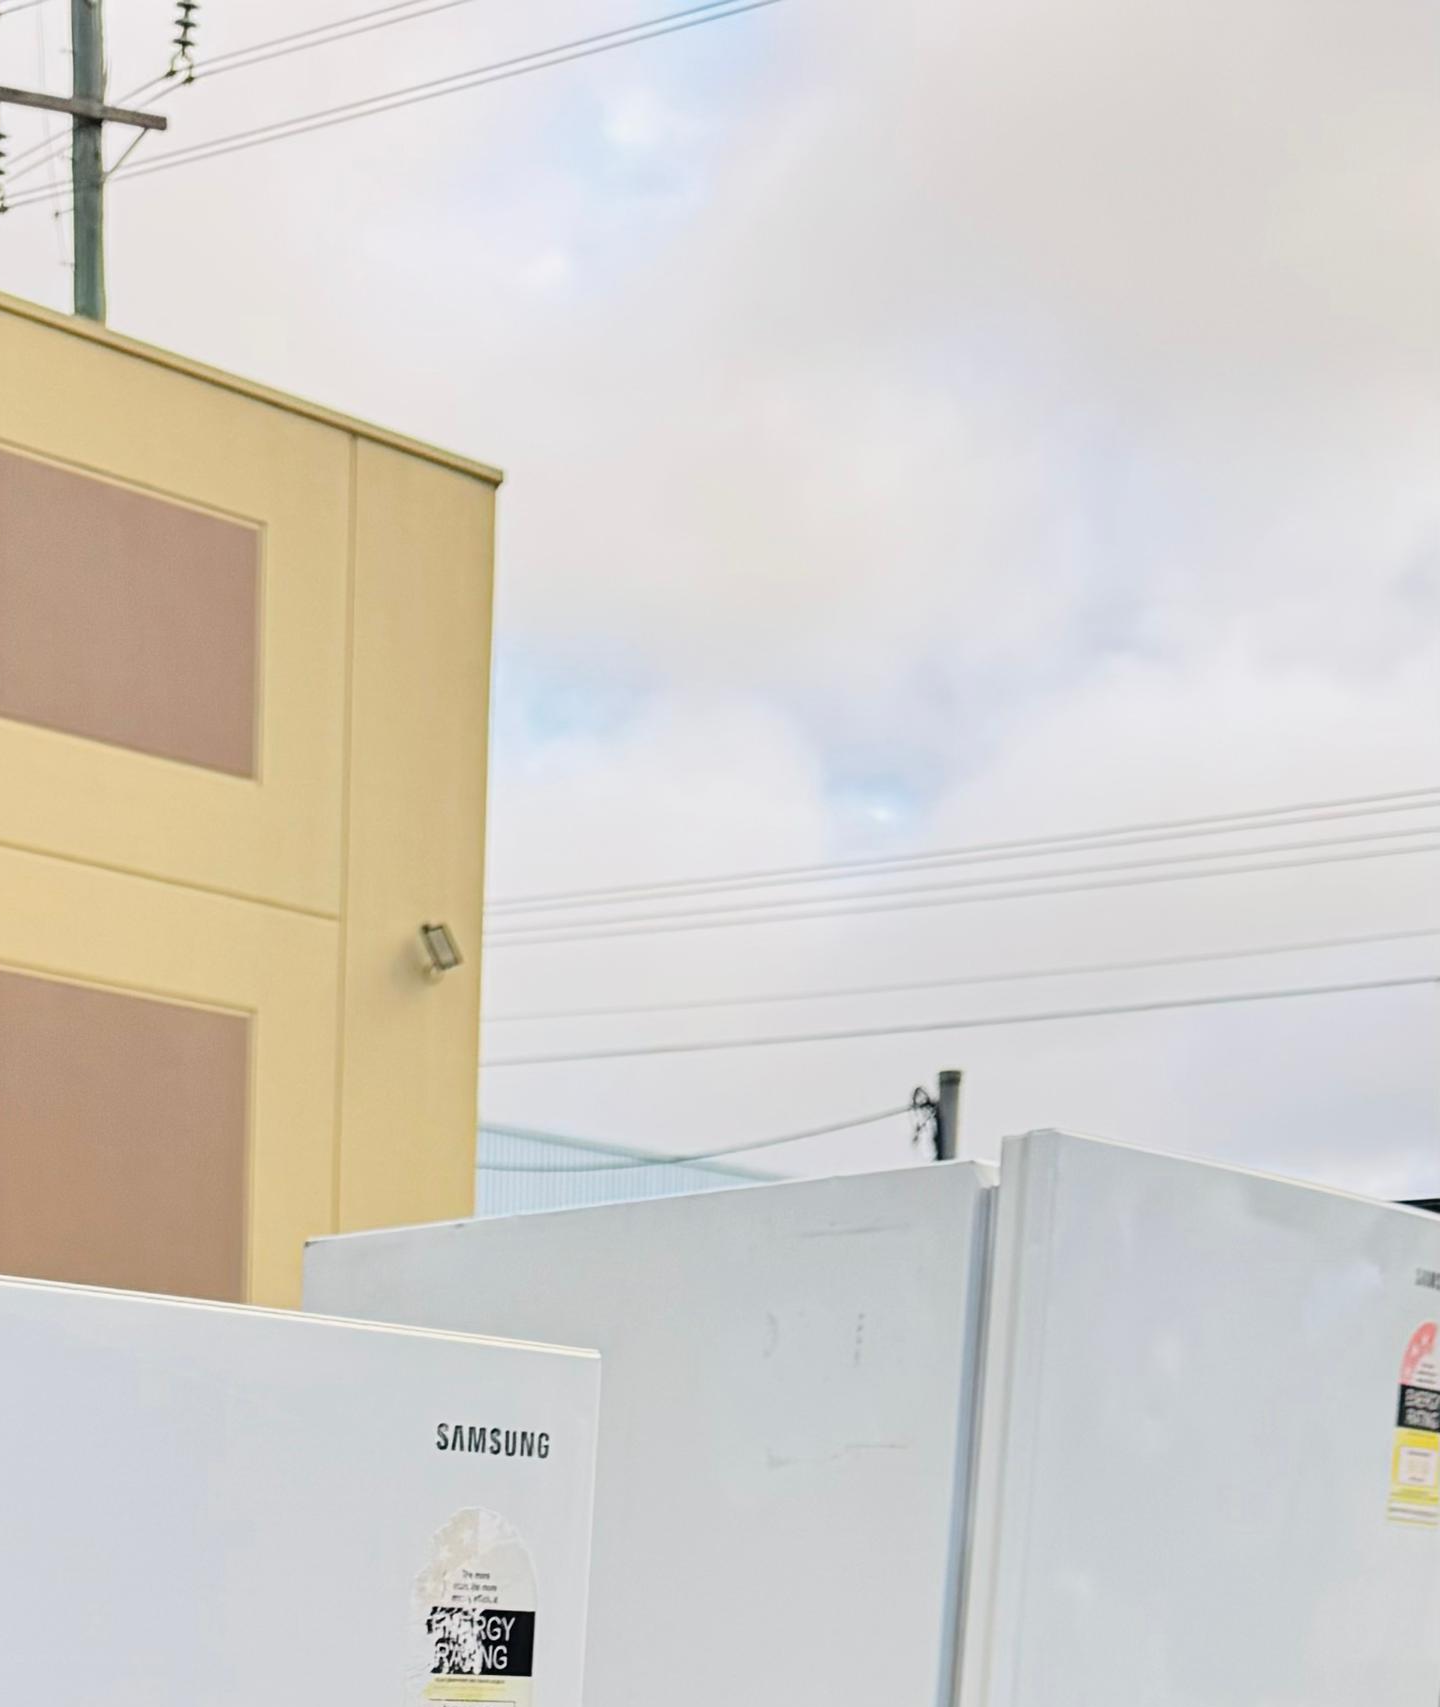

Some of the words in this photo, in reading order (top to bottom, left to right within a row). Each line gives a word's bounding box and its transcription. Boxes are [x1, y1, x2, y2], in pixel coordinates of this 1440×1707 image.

[436, 1423, 550, 1459] SAMSUNG
[433, 1612, 515, 1641] ENRGY
[436, 1644, 508, 1670] RANG
